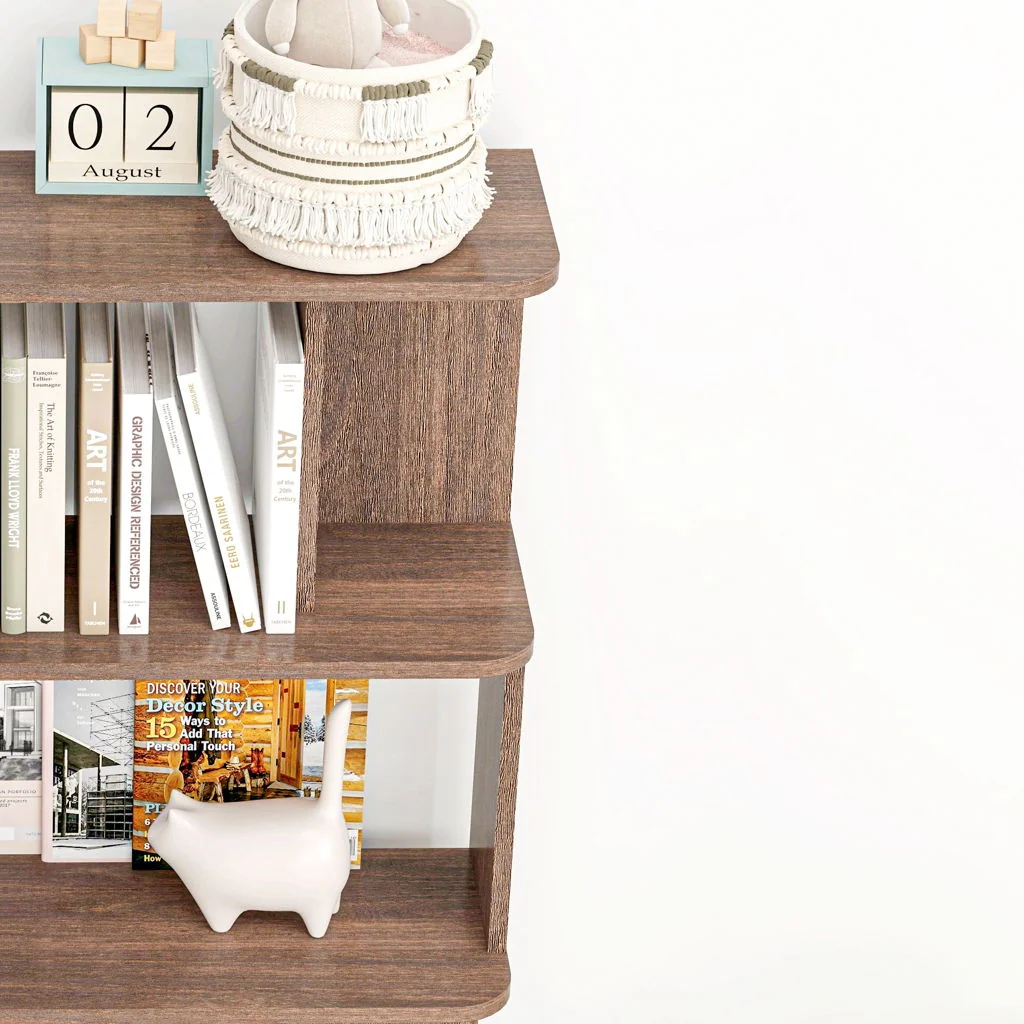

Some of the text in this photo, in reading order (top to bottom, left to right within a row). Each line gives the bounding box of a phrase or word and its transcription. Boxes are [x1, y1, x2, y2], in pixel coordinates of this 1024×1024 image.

[82, 164, 162, 182] August
[47, 402, 56, 416] The
[47, 418, 55, 432] Art
[86, 429, 108, 472] ART
[132, 416, 142, 468] GRAPHIC
[276, 430, 298, 472] ART
[44, 442, 55, 472] Knitting
[8, 448, 20, 548] FRANK LLOYD WRIGHT
[130, 471, 142, 512] DESIGN
[182, 492, 208, 552] BORDEAUX
[214, 496, 240, 569] EERO SAARINEN
[129, 516, 142, 590] REFERENCED
[210, 592, 222, 620] ASSOULINE
[147, 682, 241, 695] DISCOVER YOUR
[146, 697, 264, 717] Decor Style
[146, 716, 176, 739] 15
[180, 716, 226, 727] Ways to
[180, 728, 233, 738] Add That
[146, 741, 236, 752] Personal Touch
